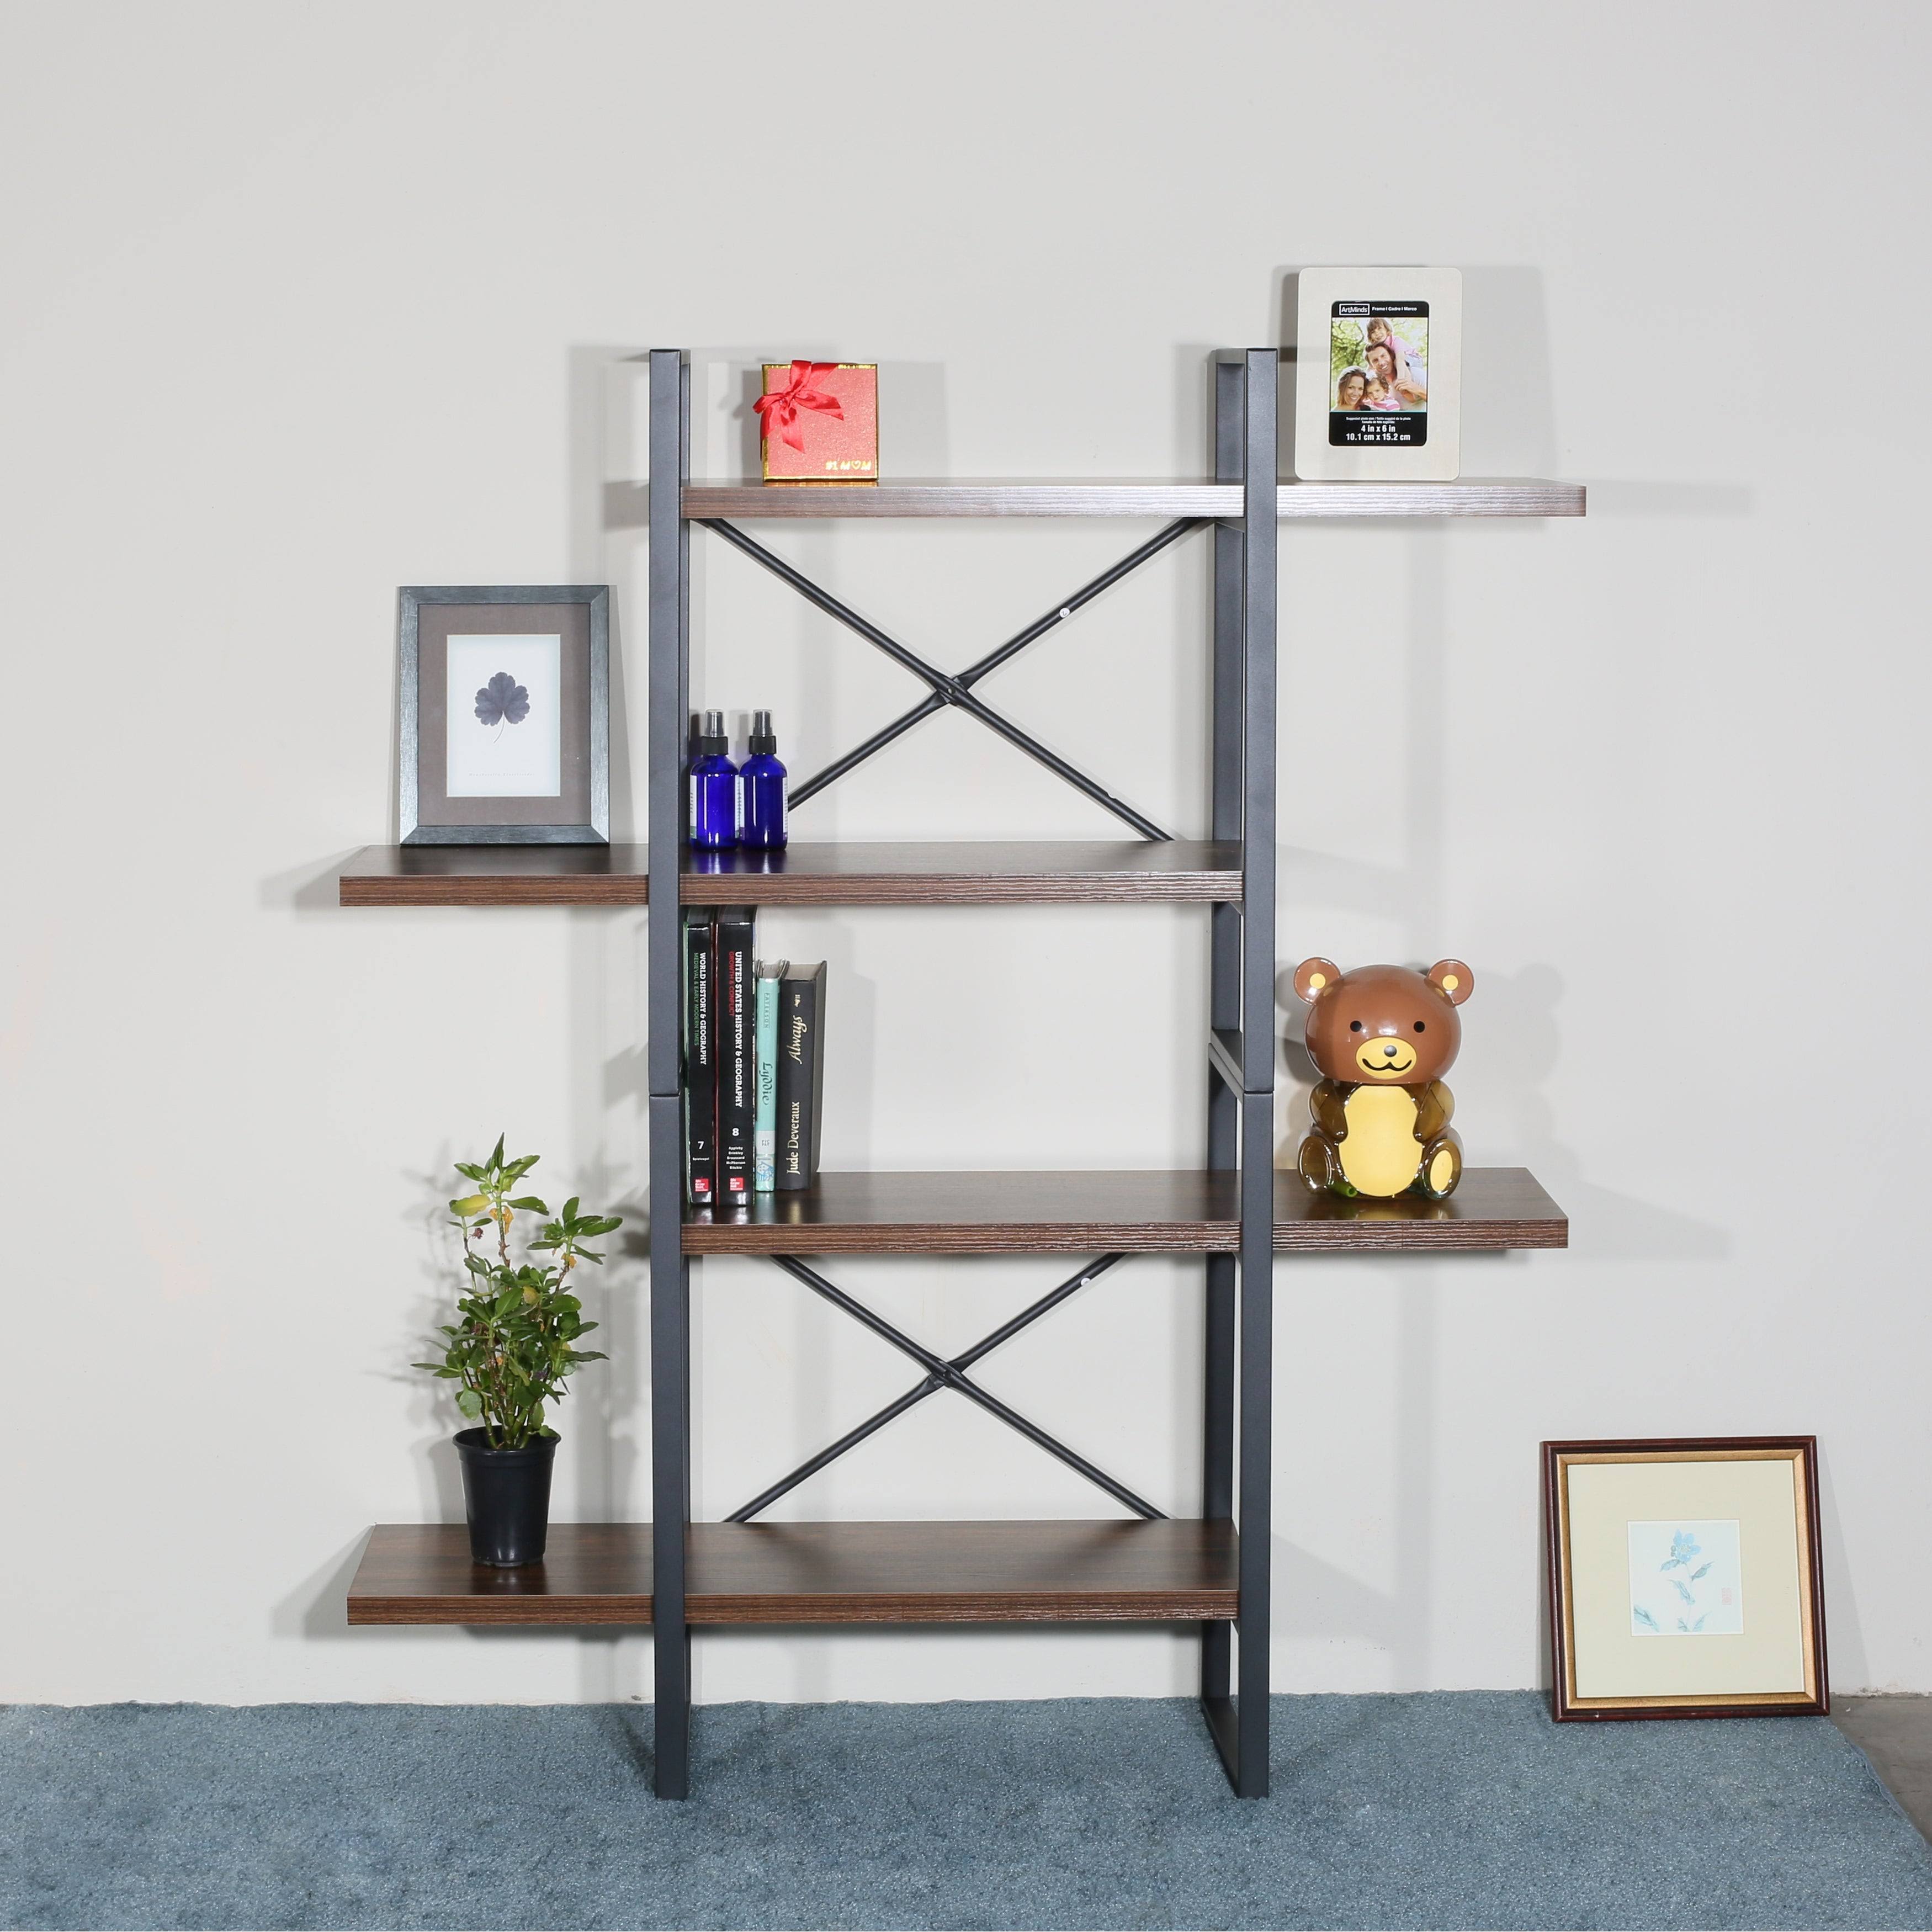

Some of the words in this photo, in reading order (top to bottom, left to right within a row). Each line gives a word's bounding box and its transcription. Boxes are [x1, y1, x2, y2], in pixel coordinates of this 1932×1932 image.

[787, 1015, 807, 1064] Always
[732, 1128, 739, 1136] 8
[788, 1101, 800, 1149] Deveraux
[698, 1141, 704, 1149] 7
[786, 1152, 800, 1175] Jude
